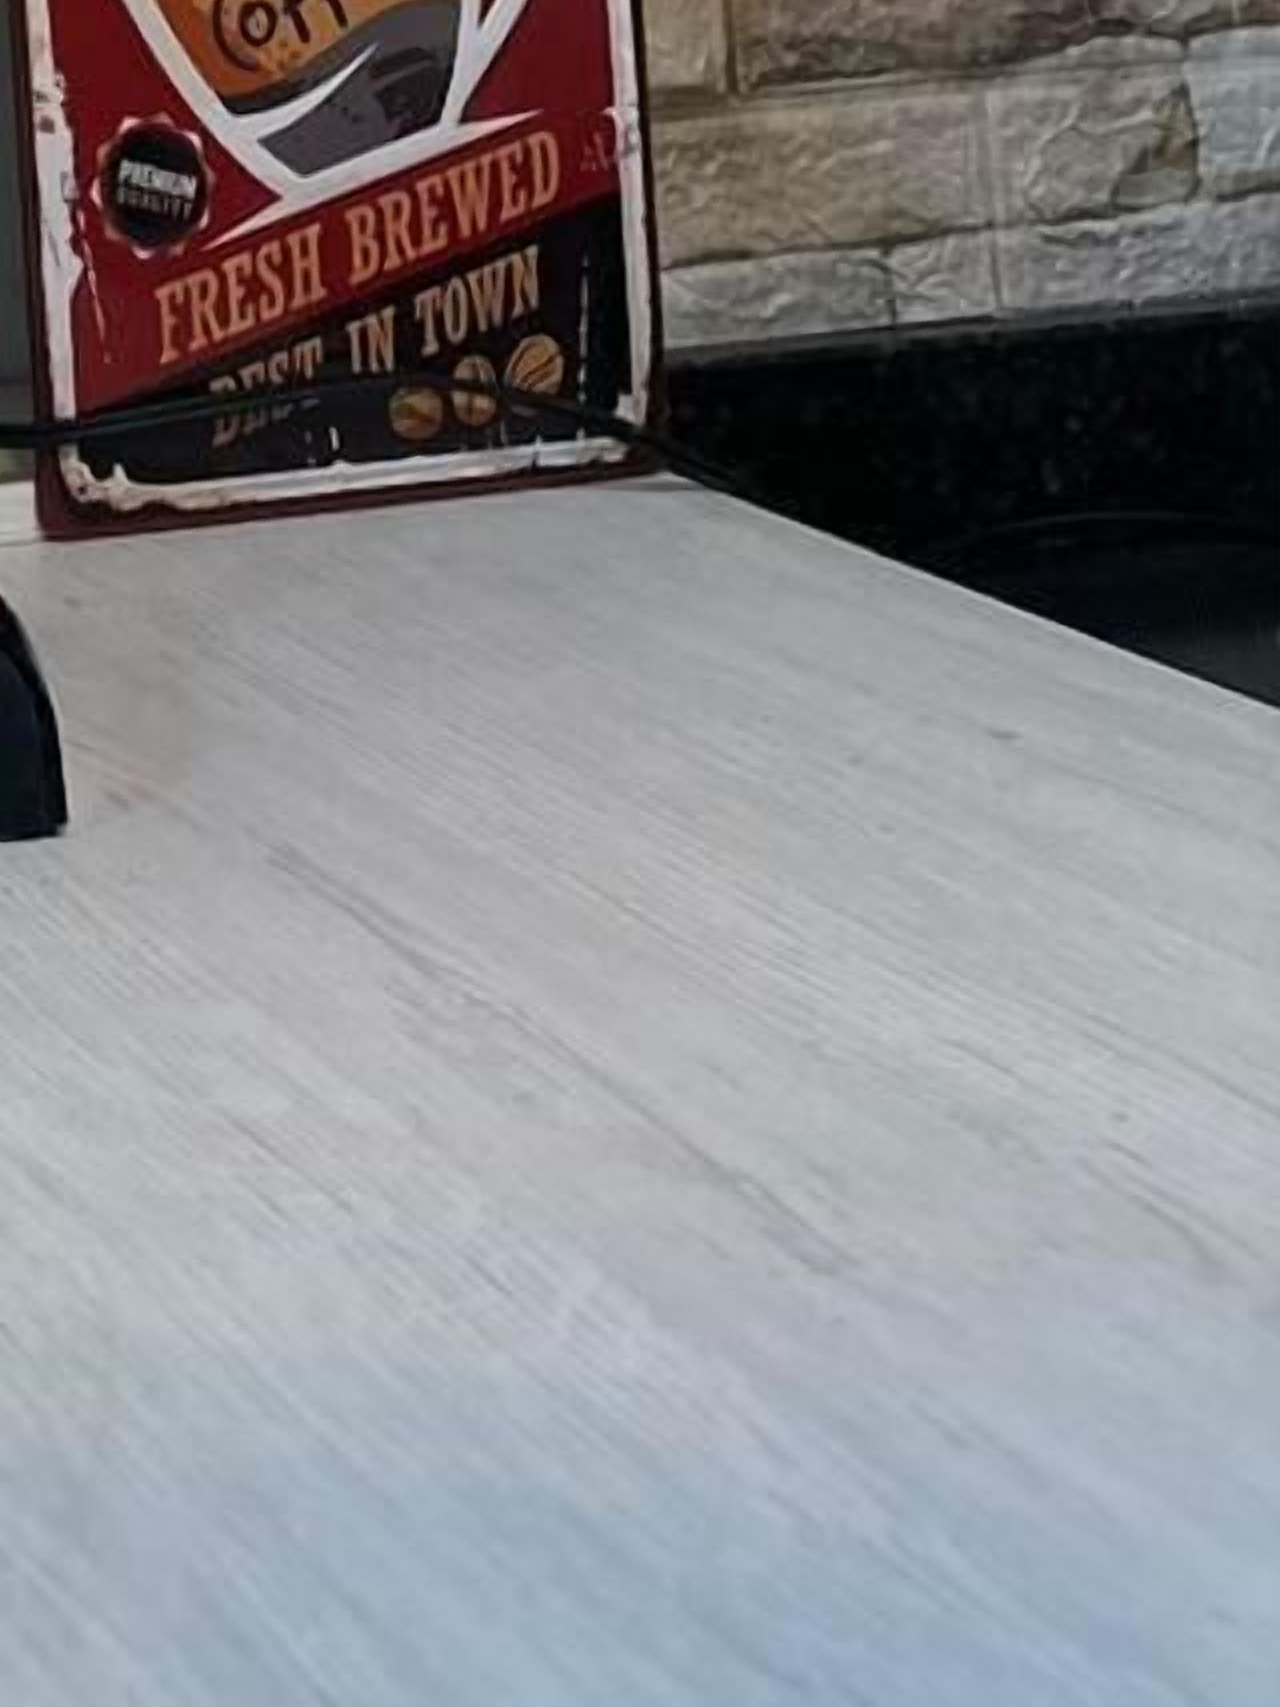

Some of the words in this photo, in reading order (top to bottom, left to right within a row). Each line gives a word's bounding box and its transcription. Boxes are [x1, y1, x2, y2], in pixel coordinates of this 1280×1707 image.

[152, 222, 328, 367] FRESH
[343, 130, 561, 287] BREWED
[344, 304, 397, 374] IN
[414, 243, 541, 356] TOWN
